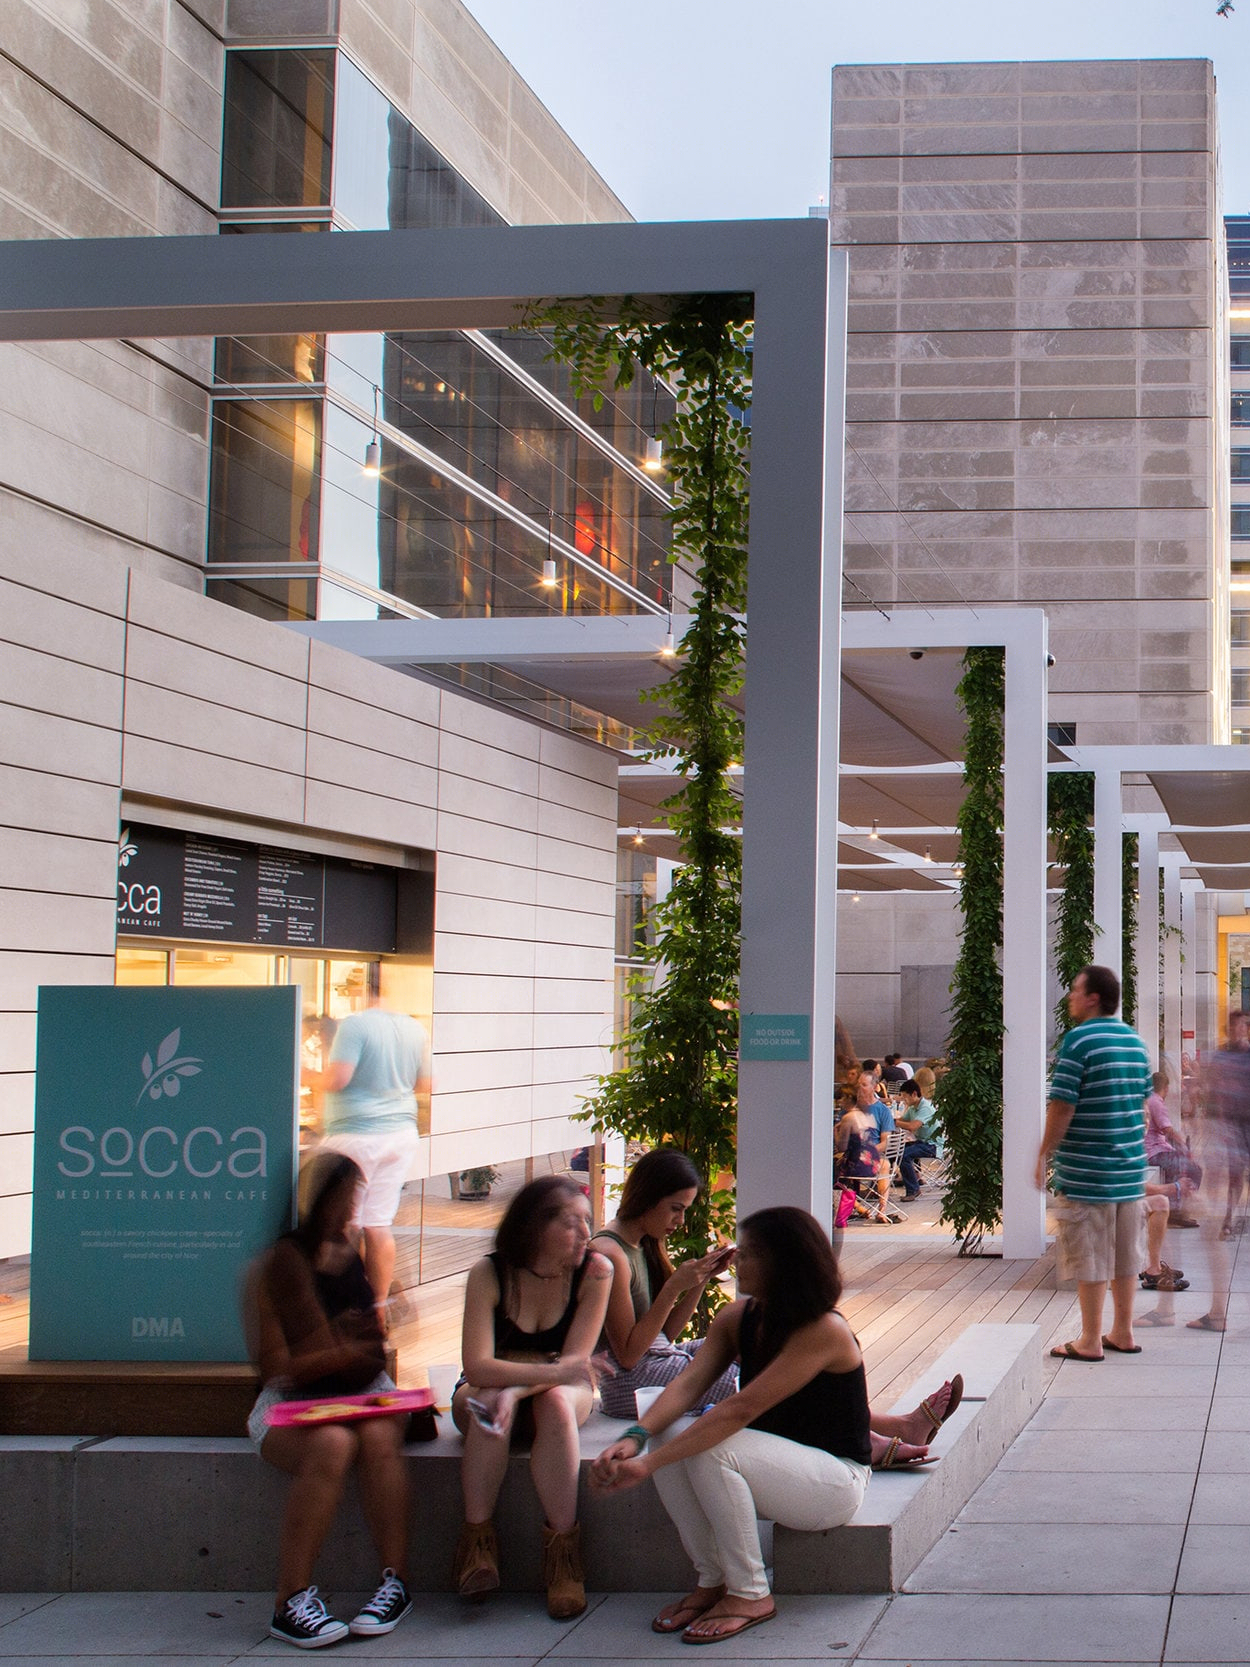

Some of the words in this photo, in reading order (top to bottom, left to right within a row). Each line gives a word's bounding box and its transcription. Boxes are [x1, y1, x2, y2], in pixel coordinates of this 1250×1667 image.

[57, 1125, 267, 1179] socca
[56, 1190, 211, 1201] MEDITERRANEAN
[225, 1190, 268, 1201] CAFE
[132, 1317, 186, 1337] DMA
